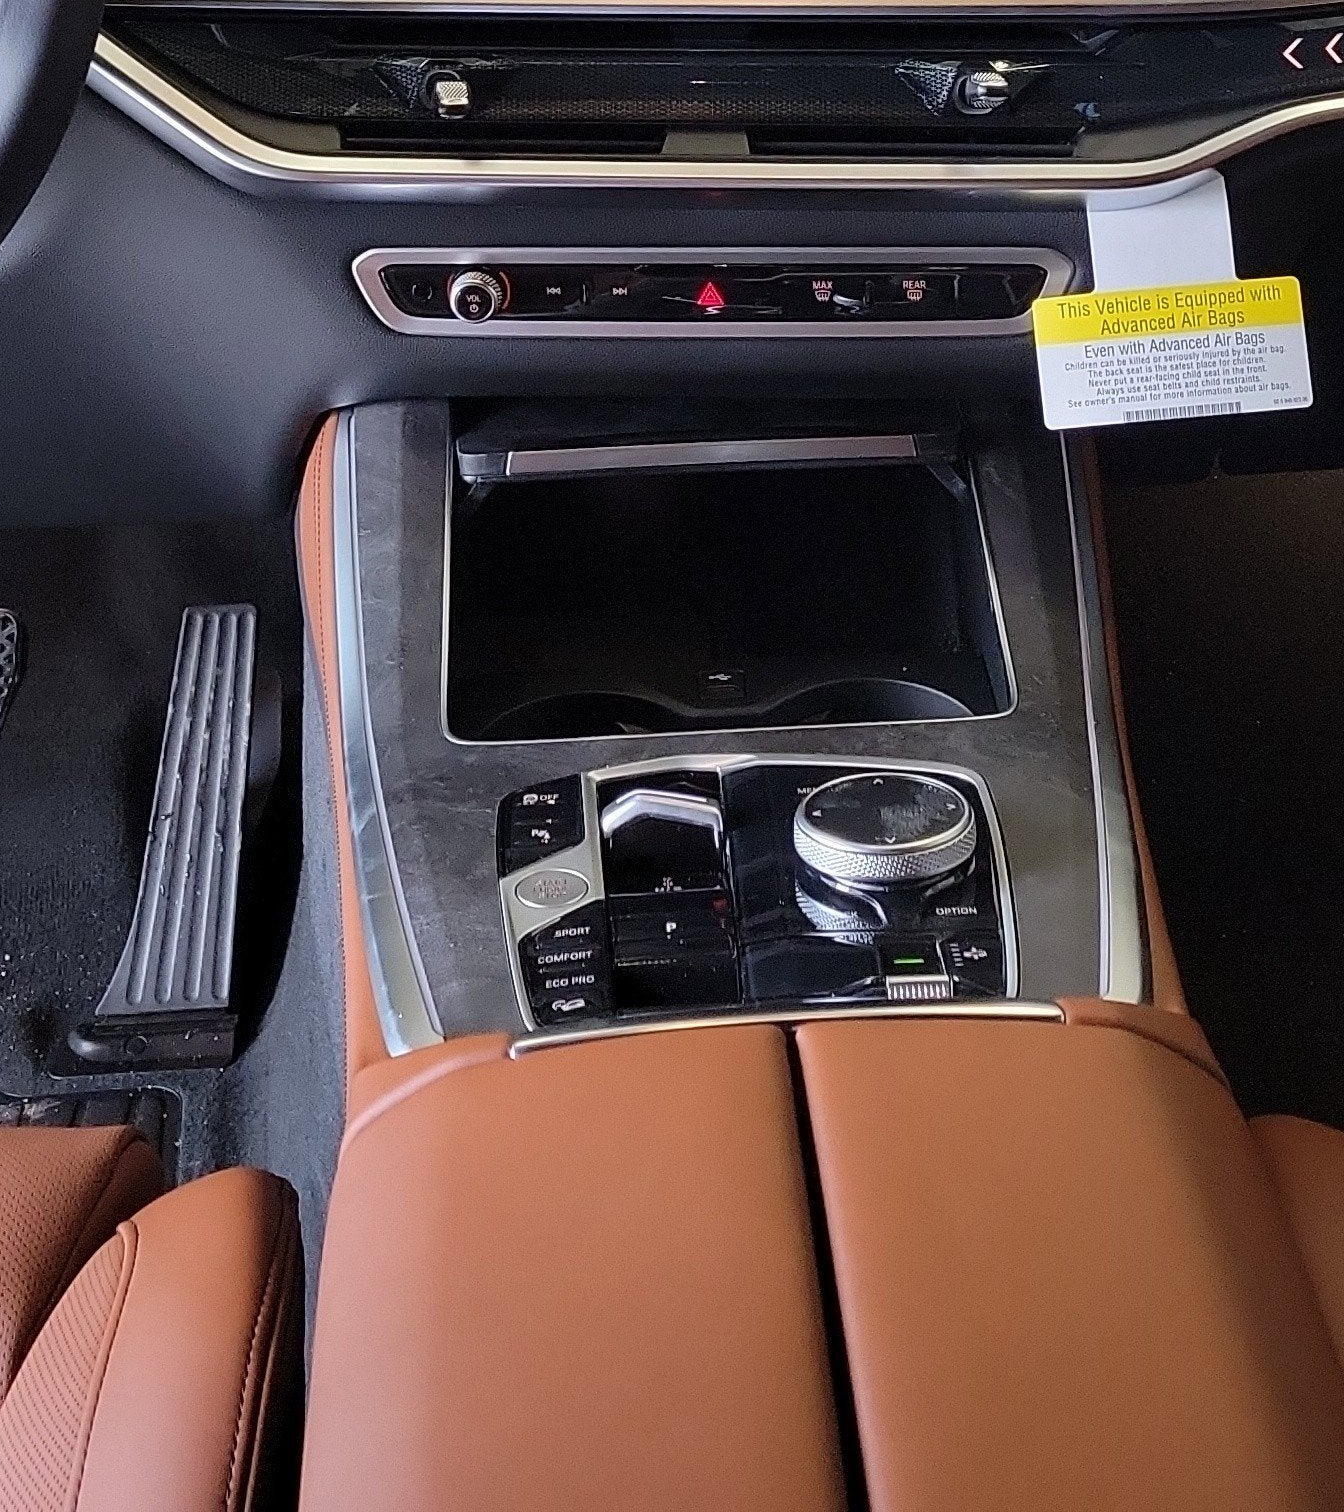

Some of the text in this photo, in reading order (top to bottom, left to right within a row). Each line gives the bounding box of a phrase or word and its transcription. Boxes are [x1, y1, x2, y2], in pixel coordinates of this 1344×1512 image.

[812, 280, 833, 289] MAX
[902, 280, 926, 289] REAR
[466, 294, 482, 303] VOL
[1057, 284, 1281, 319] This Vehicle is Equipped with
[1101, 309, 1245, 336] Advanced Air Bags
[1084, 331, 1266, 359] Even with Advanced Air Bags
[1065, 361, 1098, 371] Children
[1100, 359, 1115, 368] can
[1117, 357, 1127, 366] be
[1129, 356, 1151, 365] killed
[1153, 355, 1162, 363] or
[1164, 351, 1200, 363] seriously
[1202, 349, 1230, 360] injured
[1232, 348, 1241, 358] by
[1243, 346, 1256, 355] the
[1258, 345, 1268, 354] air
[1088, 369, 1103, 378] The
[1105, 367, 1124, 377] back
[1126, 366, 1143, 375] seat
[1145, 365, 1153, 373] is
[1155, 364, 1167, 372] the
[1170, 361, 1194, 371] safest
[1196, 360, 1217, 370] place
[1219, 358, 1230, 367] for
[1088, 378, 1111, 388] Never
[1114, 376, 1128, 387] put
[1137, 372, 1180, 383] rear-facing
[1182, 369, 1202, 379] child
[1204, 368, 1221, 377] seat
[1222, 367, 1230, 375] in
[1232, 366, 1244, 375] the
[1067, 399, 1082, 408] See
[1084, 396, 1116, 407] owner's
[1118, 393, 1147, 403] manual
[1149, 392, 1161, 401] for
[1164, 390, 1185, 400] more
[1187, 386, 1233, 398] information
[1234, 384, 1256, 394] about
[1258, 383, 1268, 391] air
[1096, 387, 1125, 397] Always
[1127, 385, 1141, 394] use
[1144, 383, 1160, 392] seat
[1162, 381, 1182, 390] belts
[1184, 379, 1199, 388] and
[1201, 377, 1221, 386] child
[935, 906, 978, 916] OPTION
[553, 926, 591, 938] SPORT
[665, 921, 677, 933] P
[537, 950, 593, 965] COMFORT
[545, 974, 595, 989] ECO PRO
